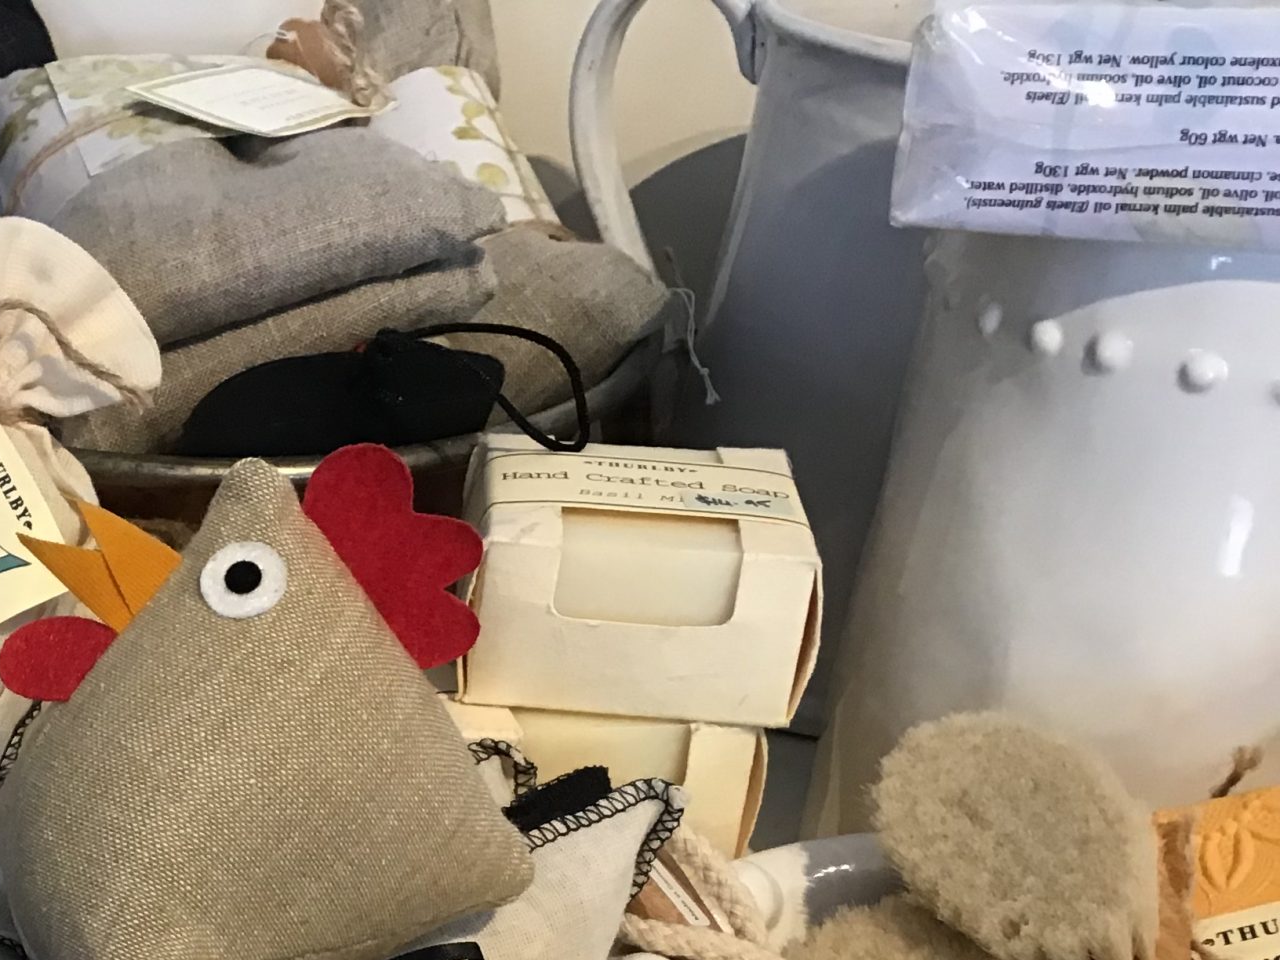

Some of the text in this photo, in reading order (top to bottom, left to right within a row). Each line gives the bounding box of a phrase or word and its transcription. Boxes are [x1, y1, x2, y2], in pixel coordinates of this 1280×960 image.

[1069, 50, 1094, 66] wgt
[1098, 52, 1122, 68] Net
[1179, 54, 1226, 69] colour
[1156, 73, 1192, 88] olive
[1222, 75, 1280, 89] coconut
[1145, 91, 1182, 106] palm
[1184, 93, 1266, 108] sustainable
[1180, 128, 1269, 147] Net wgt 60g
[1034, 161, 1069, 178] 130g
[1075, 162, 1100, 177] wgt
[1104, 165, 1129, 180] Net
[1193, 168, 1263, 183] cinnamon
[1010, 180, 1063, 195] distilled
[1142, 184, 1194, 199] sodium
[1223, 187, 1258, 202] olive
[1094, 200, 1111, 213] oil
[1164, 202, 1199, 215] palm
[592, 460, 689, 474] THURLBY
[500, 469, 790, 501] Hand Crafted Soap
